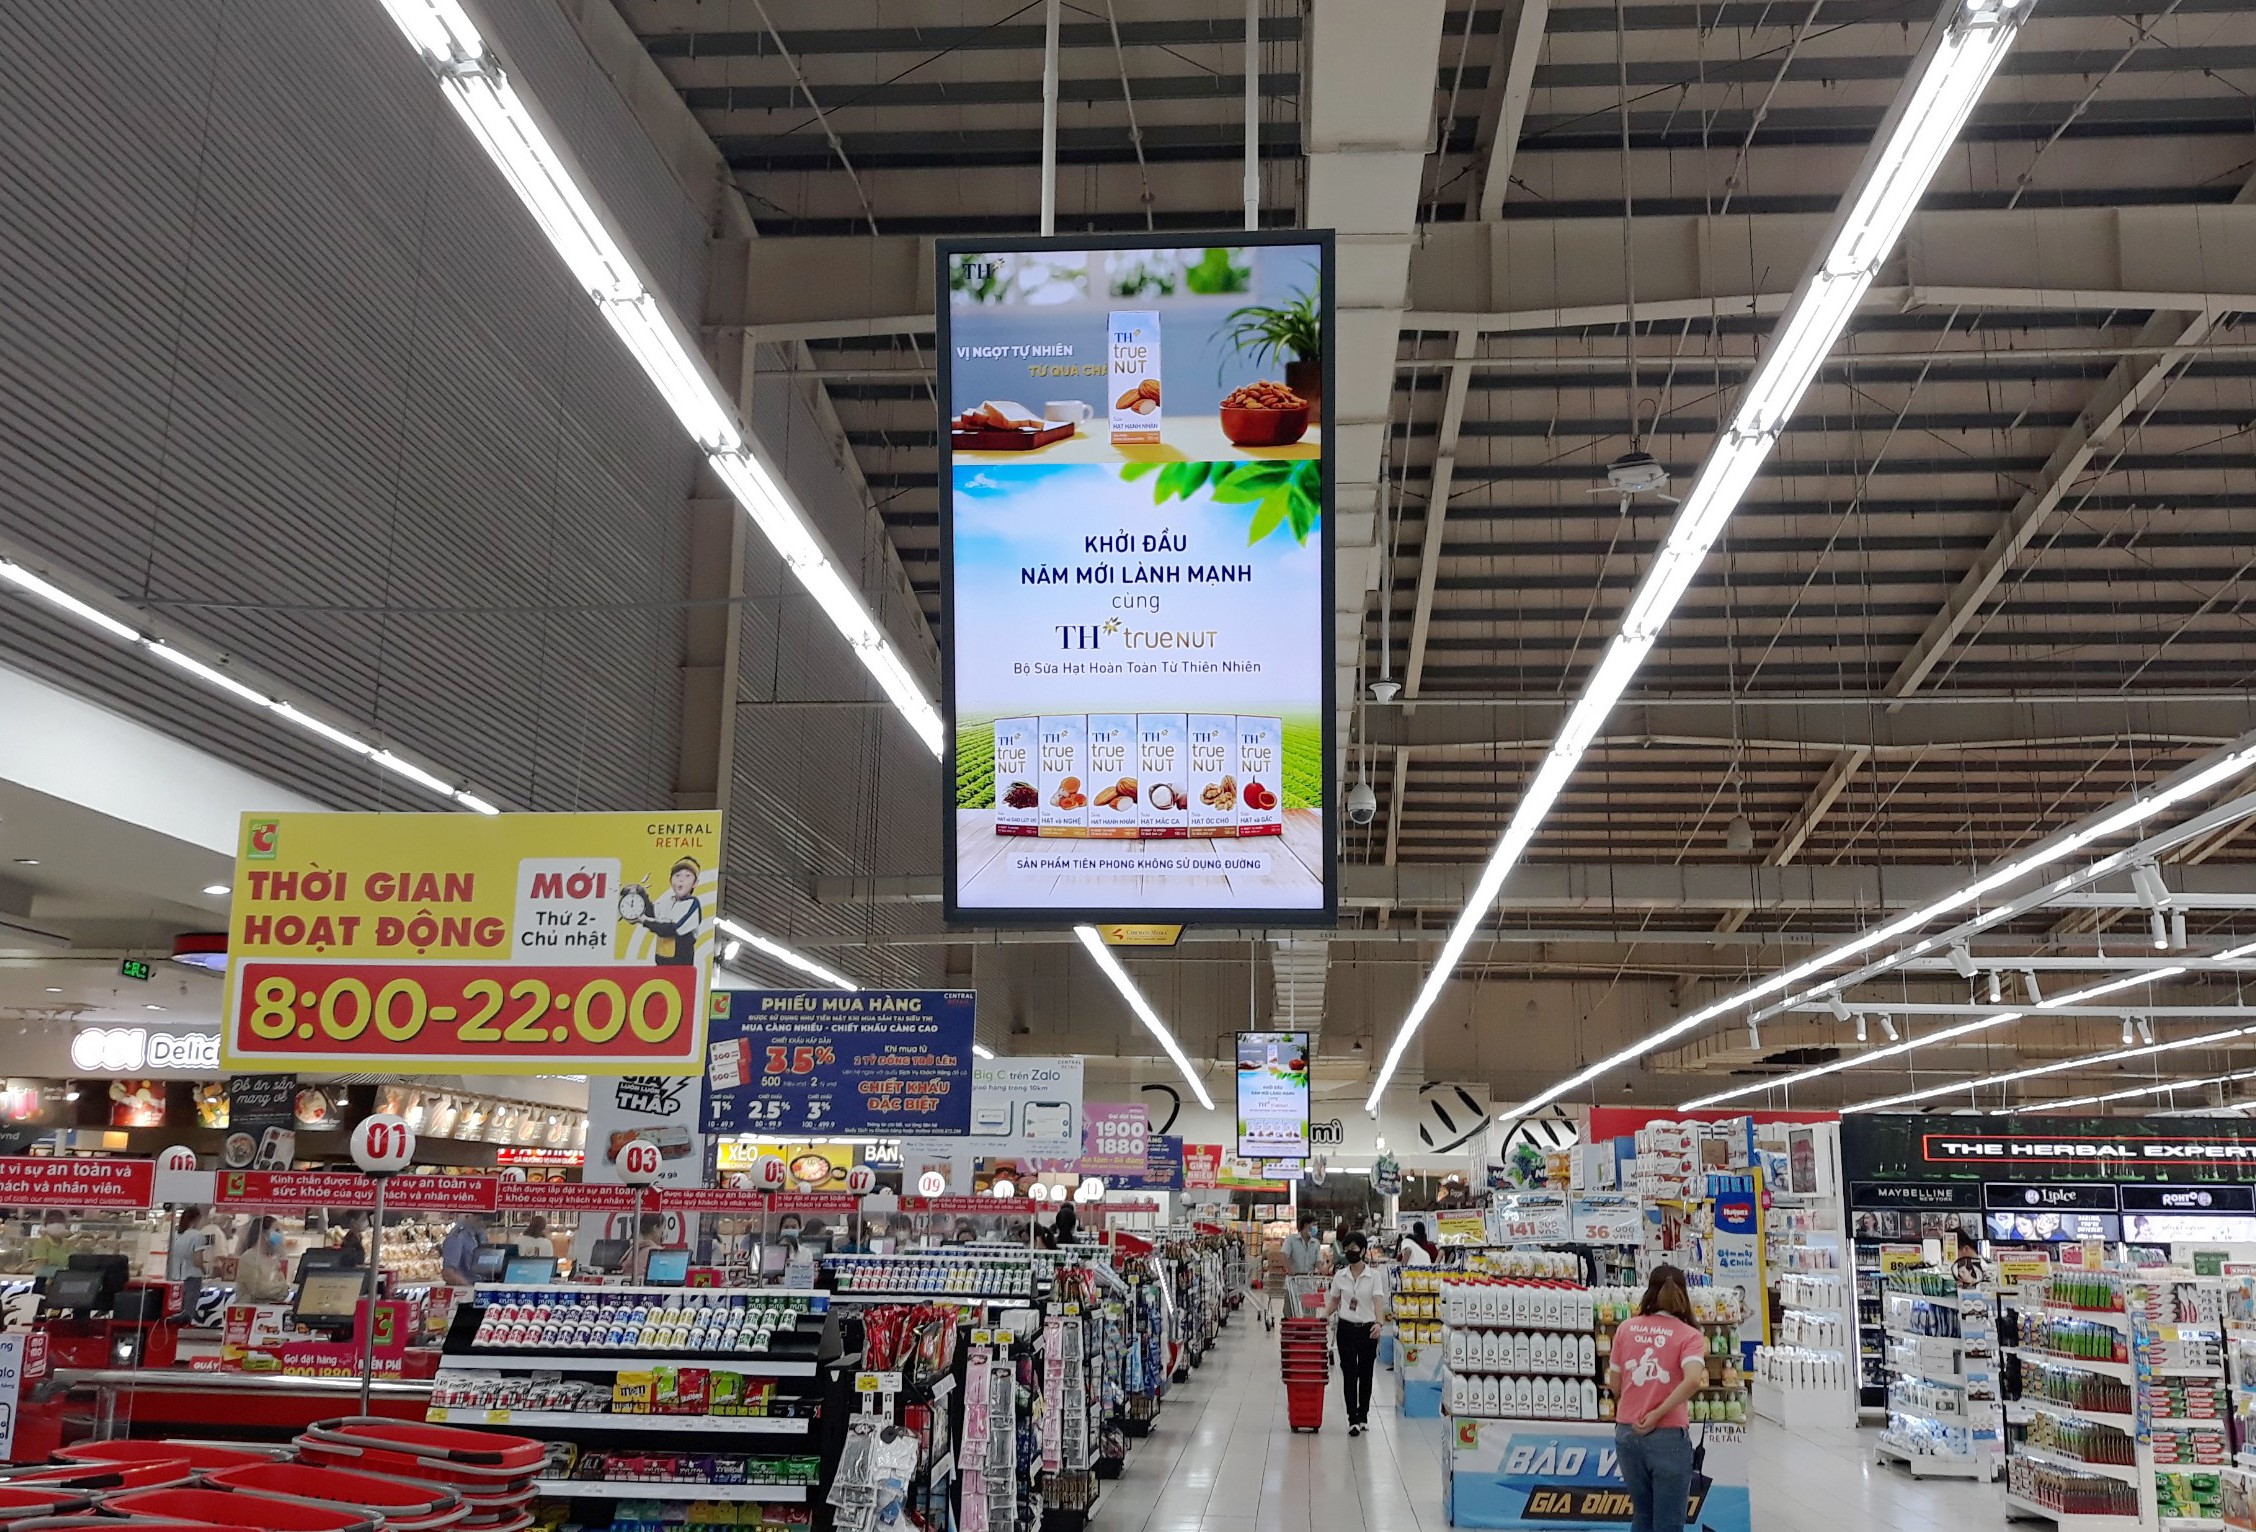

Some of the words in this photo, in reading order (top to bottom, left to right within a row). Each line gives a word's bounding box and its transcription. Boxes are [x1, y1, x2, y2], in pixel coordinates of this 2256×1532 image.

[962, 263, 991, 280] TH
[1114, 332, 1133, 343] TH
[972, 346, 1009, 361] NGỌT
[1032, 342, 1073, 357] NHIÊN
[1114, 343, 1147, 359] true
[1114, 360, 1147, 374] NUT
[1084, 528, 1134, 553] KHỞI
[1142, 527, 1187, 552] ĐẦU
[1021, 562, 1068, 585] NĂM
[1076, 562, 1114, 584] MỚI
[1122, 562, 1180, 584] LÀNH
[1187, 564, 1252, 588] MẠNH
[1112, 591, 1160, 613] cùng
[1055, 624, 1101, 650] TH
[1014, 661, 1031, 678] Bộ
[1034, 660, 1058, 675] Sữa
[1062, 661, 1086, 677] Hạt
[1089, 659, 1123, 674] Hoàn
[1127, 660, 1157, 674] Toàn
[1161, 659, 1178, 674] Từ
[1181, 659, 1218, 673] Thiên
[1222, 659, 1261, 673] Nhiên
[1042, 733, 1060, 743] TH
[1092, 732, 1110, 742] TH
[1142, 732, 1160, 742] TH
[1193, 732, 1210, 742] TH
[1241, 734, 1258, 744] TH
[998, 745, 1026, 759] true
[1042, 744, 1074, 757] true
[1091, 743, 1125, 757] true
[1141, 743, 1174, 757] true
[1192, 743, 1224, 757] true
[1241, 745, 1271, 759] true
[999, 761, 1026, 773] NUT
[1043, 759, 1074, 772] NUT
[1093, 759, 1125, 772] NUT
[1142, 759, 1174, 772] NUT
[1193, 759, 1224, 772] NUT
[1242, 760, 1271, 772] NUT
[647, 823, 713, 836] CENTRAL
[655, 837, 704, 848] RETAIL
[1016, 856, 1037, 870] SẢN
[1040, 855, 1070, 870] PHẨM
[1073, 857, 1097, 870] TIÊN
[1099, 859, 1135, 870] PHONG
[1138, 856, 1173, 870] KHÔNG
[1192, 858, 1222, 872] DỤNG
[1224, 855, 1261, 869] ĐƯỜNG
[248, 862, 347, 902] THỜI
[365, 871, 474, 902] GIAN
[530, 866, 607, 900] MỚI
[536, 910, 573, 927] Thứ
[244, 915, 360, 953] HOẠT
[375, 909, 505, 955] ĐỘNG
[521, 928, 558, 948] Chủ
[565, 930, 607, 948] nhật
[249, 976, 683, 1044] 8:00-22:00
[761, 993, 817, 1012] PHIẾU
[822, 998, 863, 1011] MUA
[869, 995, 922, 1012] HÀNG
[741, 1024, 763, 1032] MUA
[765, 1023, 792, 1032] CÀNG
[794, 1022, 823, 1032] NHIỀU
[831, 1022, 859, 1032] CHIẾT
[861, 1022, 887, 1032] KHẤU
[889, 1023, 916, 1032] CÀNG
[918, 1024, 938, 1032] CAO
[764, 1045, 835, 1075] 3.5%
[935, 1054, 957, 1066] LÊN
[761, 1076, 780, 1087] 500
[810, 1077, 817, 1087] 2
[974, 1069, 993, 1081] Big
[997, 1070, 1006, 1080] C
[1010, 1071, 1029, 1080] trên
[1031, 1069, 1061, 1081] Zalo
[232, 1078, 251, 1093] Đồ
[253, 1079, 271, 1092] ăn
[858, 1077, 903, 1094] CHIẾT
[905, 1077, 950, 1094] KHẤU
[236, 1093, 271, 1104] mang
[867, 1095, 902, 1114] ĐẶC
[903, 1095, 939, 1114] BIỆT
[711, 1101, 732, 1119] 1%
[748, 1100, 791, 1120] 2.5%
[807, 1101, 831, 1120] 3%
[1096, 1121, 1145, 1137] 1900
[366, 1122, 407, 1159] 01
[1096, 1138, 1145, 1155] 1880
[1941, 1142, 2004, 1156] THE
[2010, 1142, 2137, 1157] HERBAL
[627, 1146, 657, 1174] 03
[24, 1166, 44, 1178] sự
[47, 1164, 67, 1176] an
[73, 1161, 111, 1177] toàn
[115, 1164, 132, 1177] và
[764, 1160, 786, 1183] 05
[33, 1181, 50, 1192] và
[53, 1180, 88, 1193] nhân
[92, 1182, 125, 1194] viên.
[270, 1174, 294, 1184] Kính
[296, 1174, 321, 1185] chắn
[323, 1175, 351, 1188] được
[353, 1175, 370, 1188] lắp
[402, 1179, 416, 1190] sự
[419, 1178, 435, 1188] an
[438, 1176, 466, 1189] toàn
[469, 1180, 482, 1190] và
[850, 1172, 867, 1190] 07
[923, 1176, 940, 1192] 09
[272, 1185, 297, 1197] sức
[299, 1184, 331, 1198] khỏe
[333, 1187, 352, 1198] của
[354, 1188, 374, 1200] quý
[424, 1191, 450, 1201] nhân
[452, 1191, 477, 1202] viên.
[524, 1186, 545, 1195] được
[1878, 1187, 1953, 1198] MAYBELLINE
[1506, 1221, 1536, 1237] 141
[1585, 1224, 1610, 1239] 36
[1630, 1324, 1649, 1333] MUA
[1650, 1325, 1674, 1337] HÀNG
[1634, 1335, 1653, 1344] QUA
[283, 1353, 299, 1365] Gọi
[300, 1353, 314, 1365] đặt
[316, 1354, 337, 1366] hàng
[1703, 1425, 1747, 1435] CENTRAL
[1709, 1435, 1743, 1443] RETAIL
[1505, 1440, 1587, 1475] BẢO
[1529, 1492, 1572, 1514] GIA
